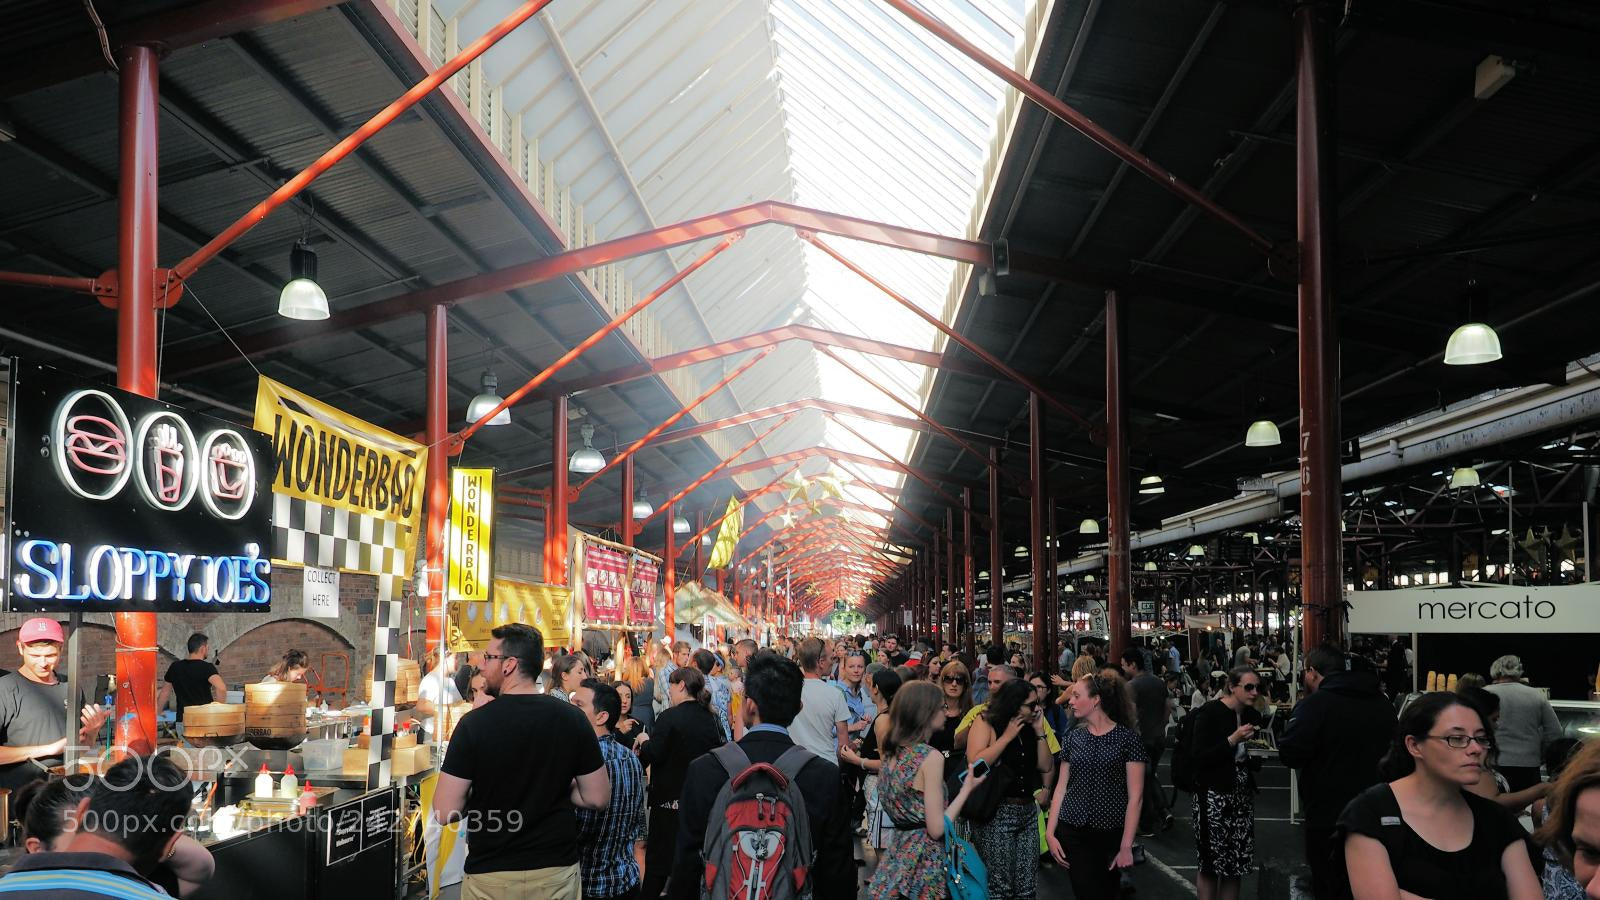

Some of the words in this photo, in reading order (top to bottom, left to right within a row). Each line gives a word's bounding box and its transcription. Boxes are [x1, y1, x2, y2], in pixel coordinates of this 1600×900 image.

[272, 413, 416, 518] WONDERBAO
[464, 475, 478, 596] WONDERBAO
[15, 539, 197, 601] SLOPPY
[189, 542, 271, 604] JOE'S
[307, 570, 336, 585] COLLECT
[312, 593, 330, 607] HERE
[1418, 594, 1556, 620] mercato
